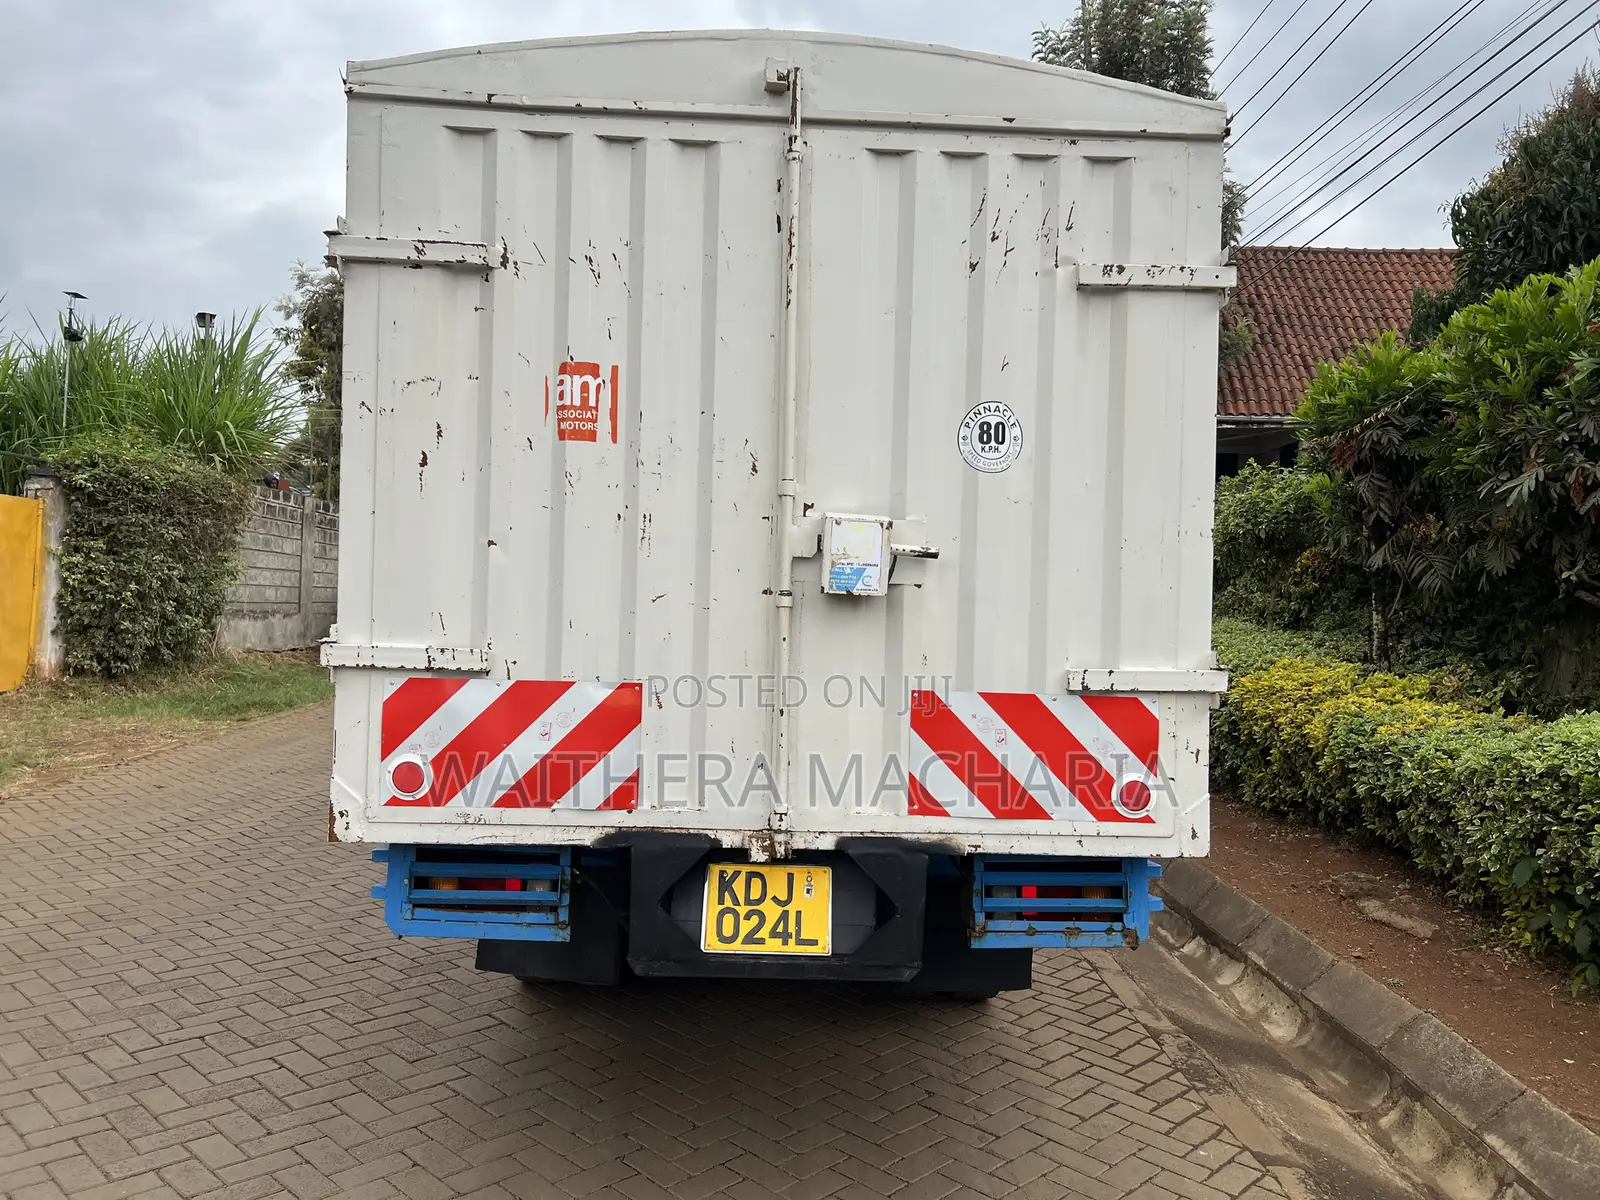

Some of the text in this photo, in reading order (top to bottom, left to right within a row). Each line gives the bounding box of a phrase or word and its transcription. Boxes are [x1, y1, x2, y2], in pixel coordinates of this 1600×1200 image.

[557, 409, 598, 420] SSOCIAT
[560, 421, 599, 431] MOTORS
[964, 404, 1018, 430] PINNACLE
[978, 421, 1006, 446] 80
[980, 445, 1002, 454] K.P.H.
[717, 869, 795, 907] KDJ
[716, 906, 819, 946] 024L
